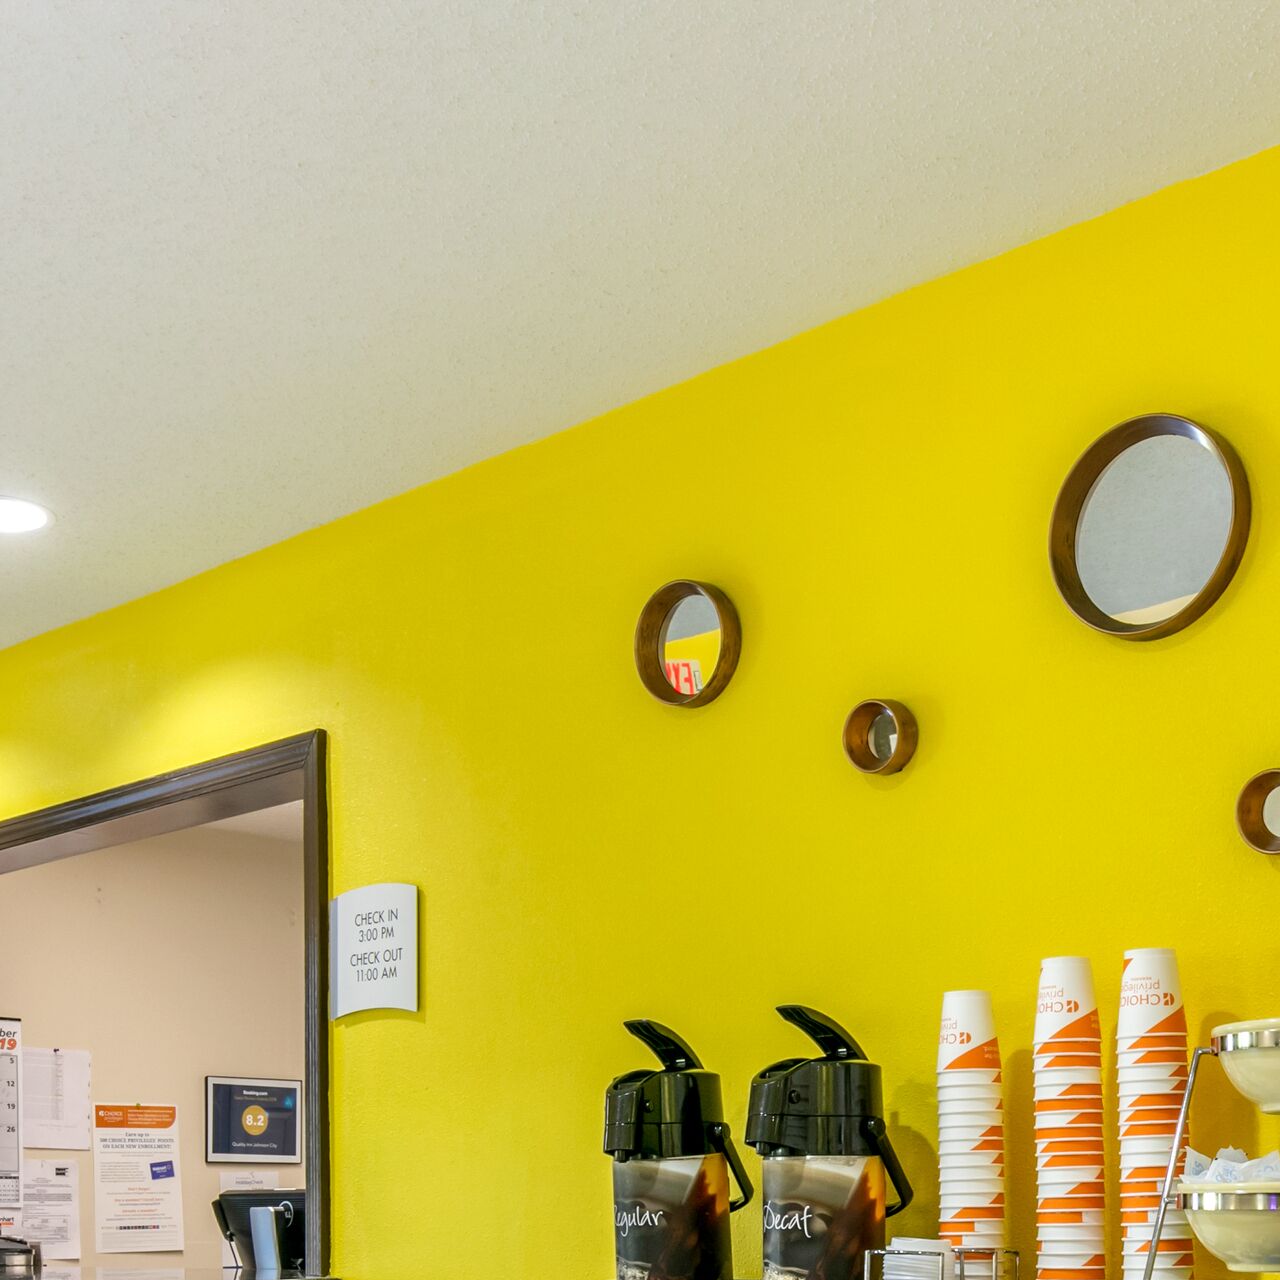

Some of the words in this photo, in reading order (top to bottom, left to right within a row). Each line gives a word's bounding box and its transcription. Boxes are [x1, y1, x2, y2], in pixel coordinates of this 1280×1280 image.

[354, 910, 385, 927] CHECK
[387, 908, 399, 921] IN
[358, 928, 378, 943] 3:00
[381, 926, 395, 939] PM
[350, 951, 380, 967] CHECK
[383, 947, 403, 963] OUT
[356, 968, 379, 982] 11:00
[381, 966, 397, 979] AM
[939, 1033, 957, 1045] CH
[245, 1114, 265, 1126] 8.2
[763, 1201, 813, 1238] Decaf
